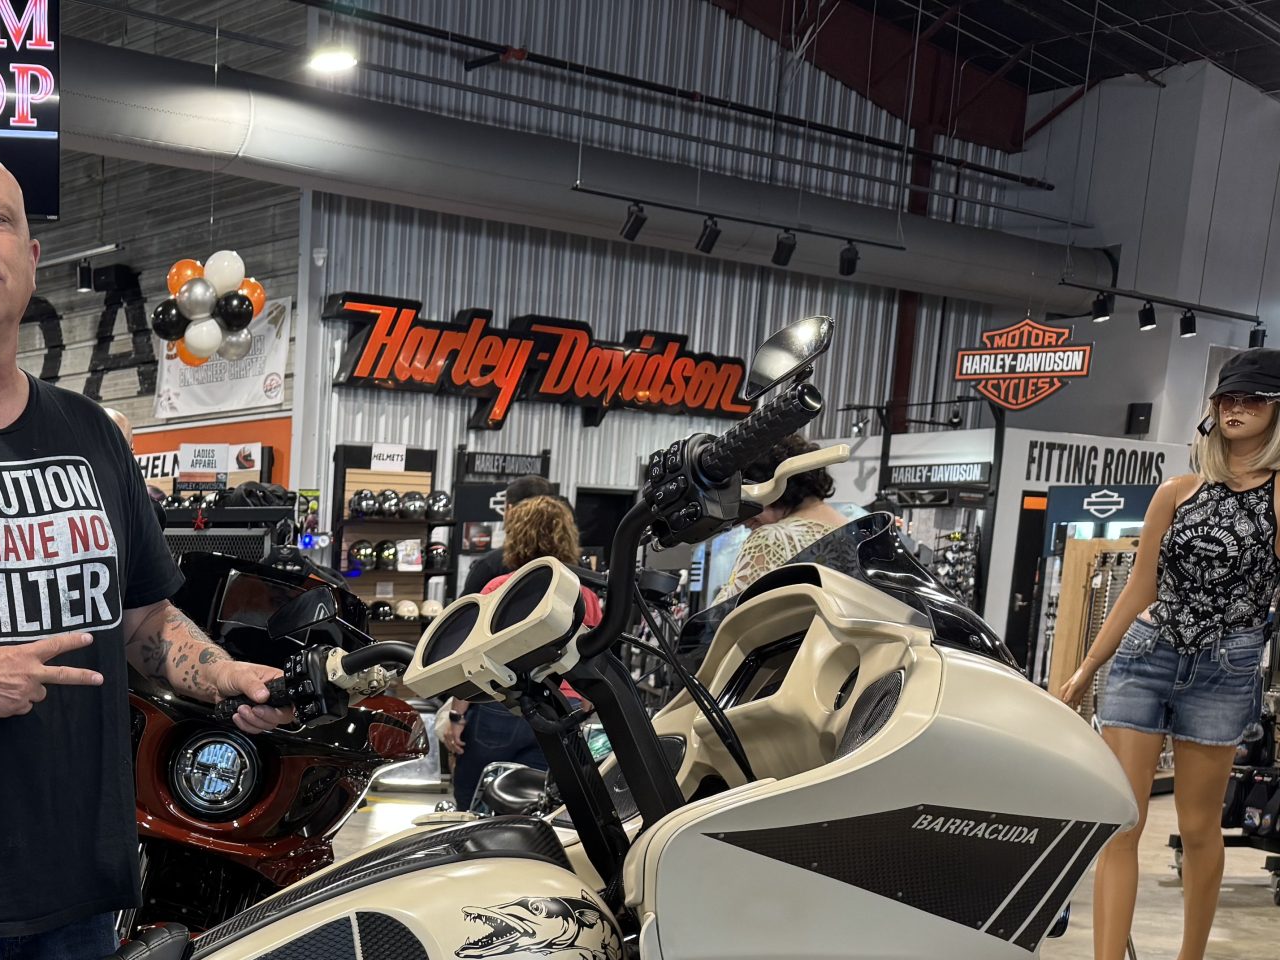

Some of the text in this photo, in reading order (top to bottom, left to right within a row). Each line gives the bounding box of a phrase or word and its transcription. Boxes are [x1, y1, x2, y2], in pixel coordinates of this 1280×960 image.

[993, 327, 1058, 348] MOTOR
[343, 301, 753, 421] Harley-Davidson
[962, 350, 1084, 375] HARLEY-DAVIDSON
[987, 378, 1052, 405] CYCLES
[190, 459, 218, 469] APPAREL
[193, 448, 216, 459] LADIES
[372, 452, 404, 463] HELMETS
[474, 453, 543, 475] HARLEY-DAVIDSON
[1025, 440, 1166, 486] FITTING ROOMS
[891, 463, 982, 484] HARLEY-DAVIDSON
[67, 514, 110, 554] NO
[1175, 525, 1239, 557] HARLEY-DAVIDSON
[911, 813, 1040, 845] BARRACUDA
